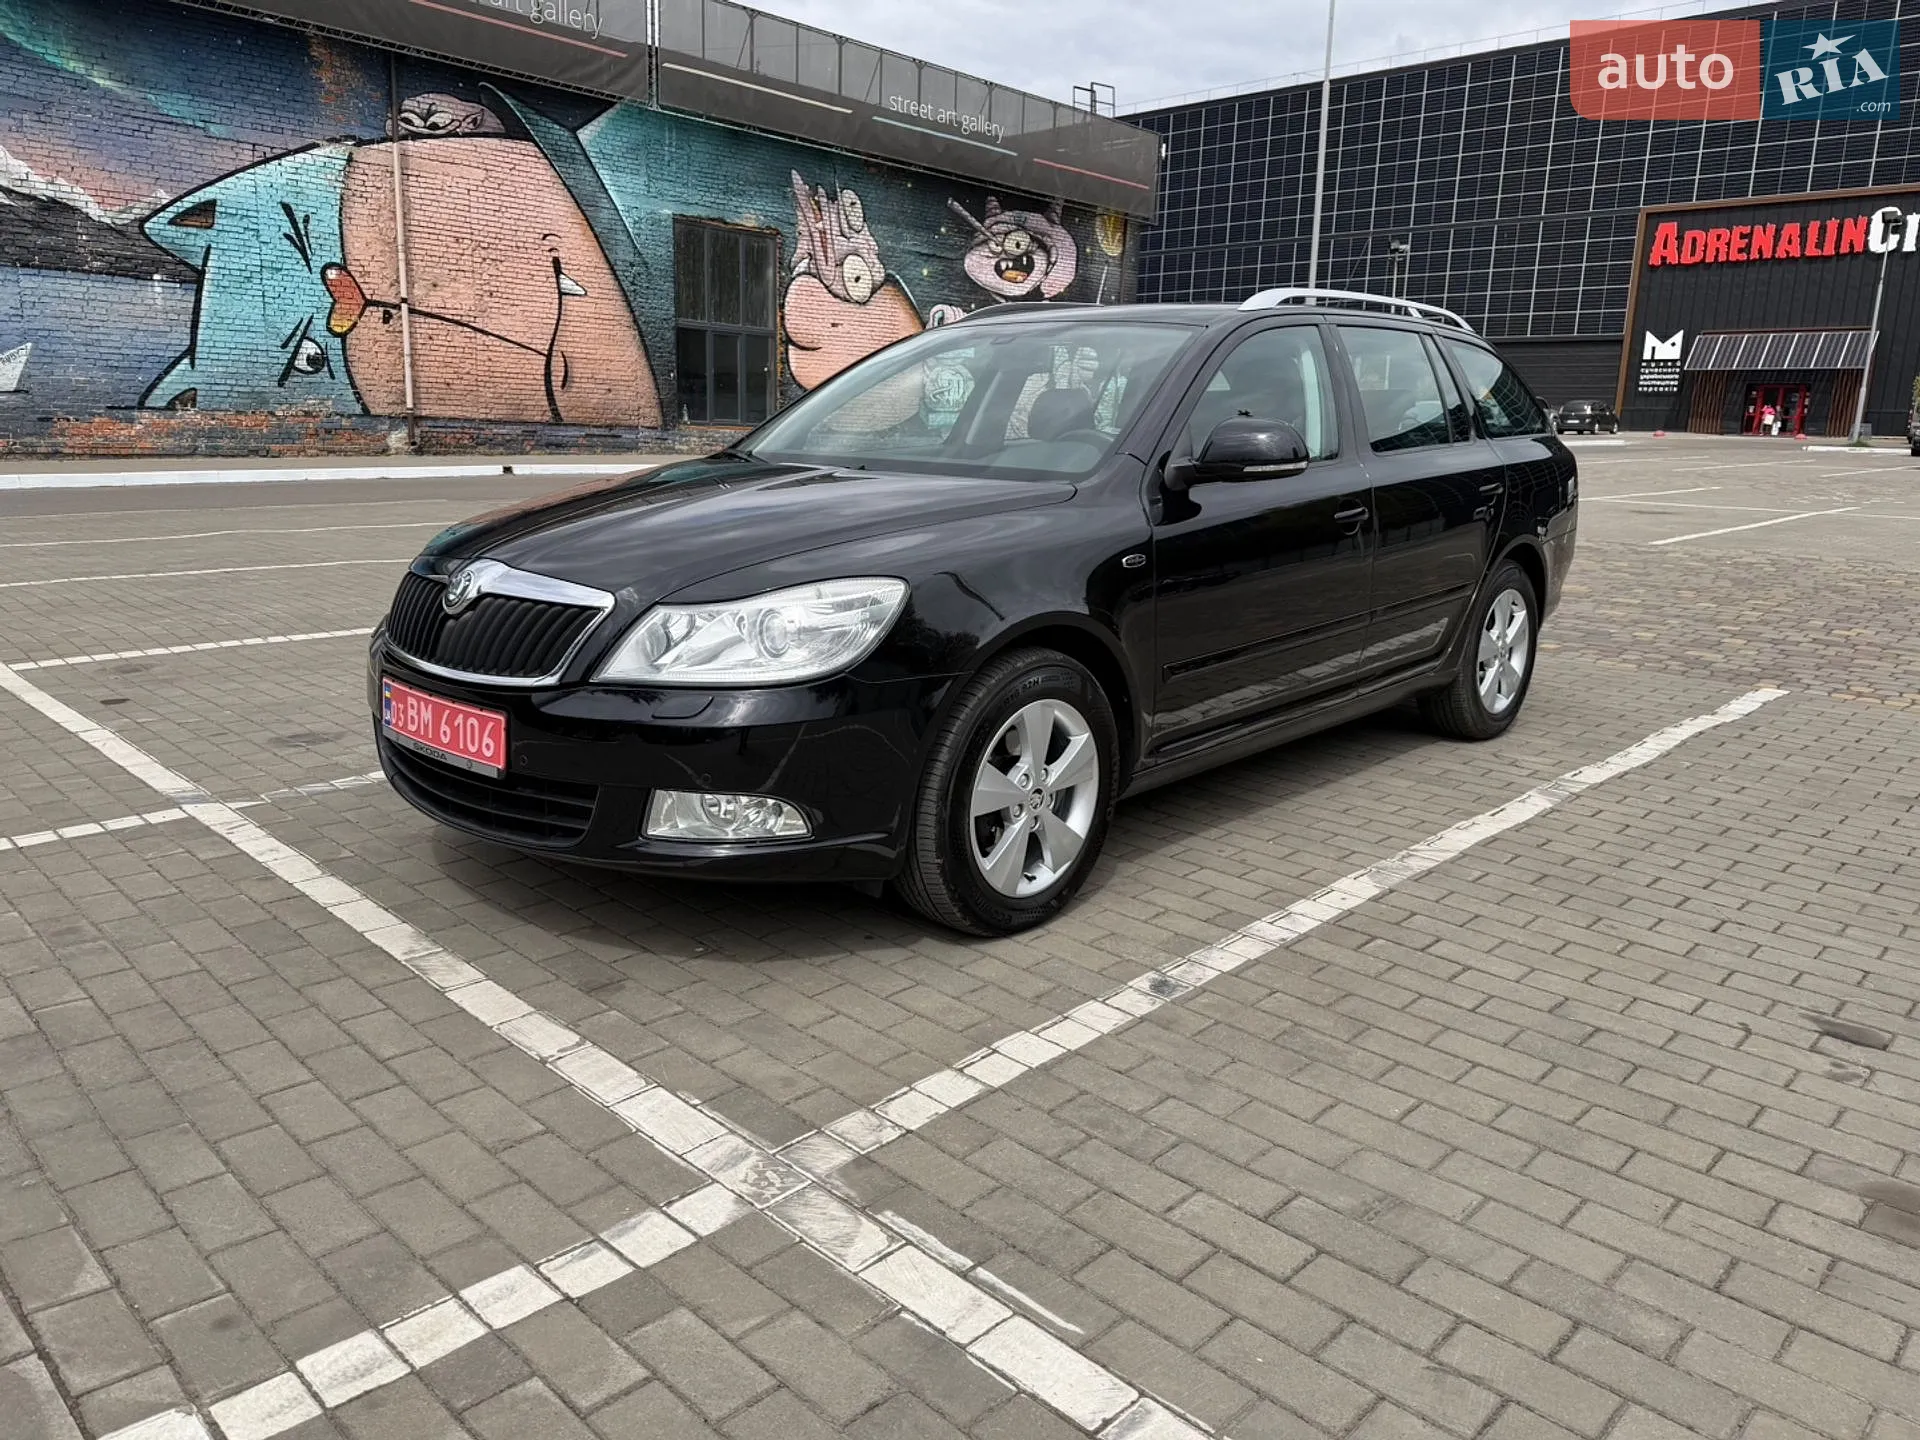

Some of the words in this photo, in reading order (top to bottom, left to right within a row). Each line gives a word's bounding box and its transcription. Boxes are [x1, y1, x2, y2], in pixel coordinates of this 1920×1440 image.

[530, 0, 603, 40] gallery
[889, 95, 934, 121] street
[937, 108, 958, 127] art
[961, 115, 1004, 143] gallery
[440, 709, 496, 758] 6106
